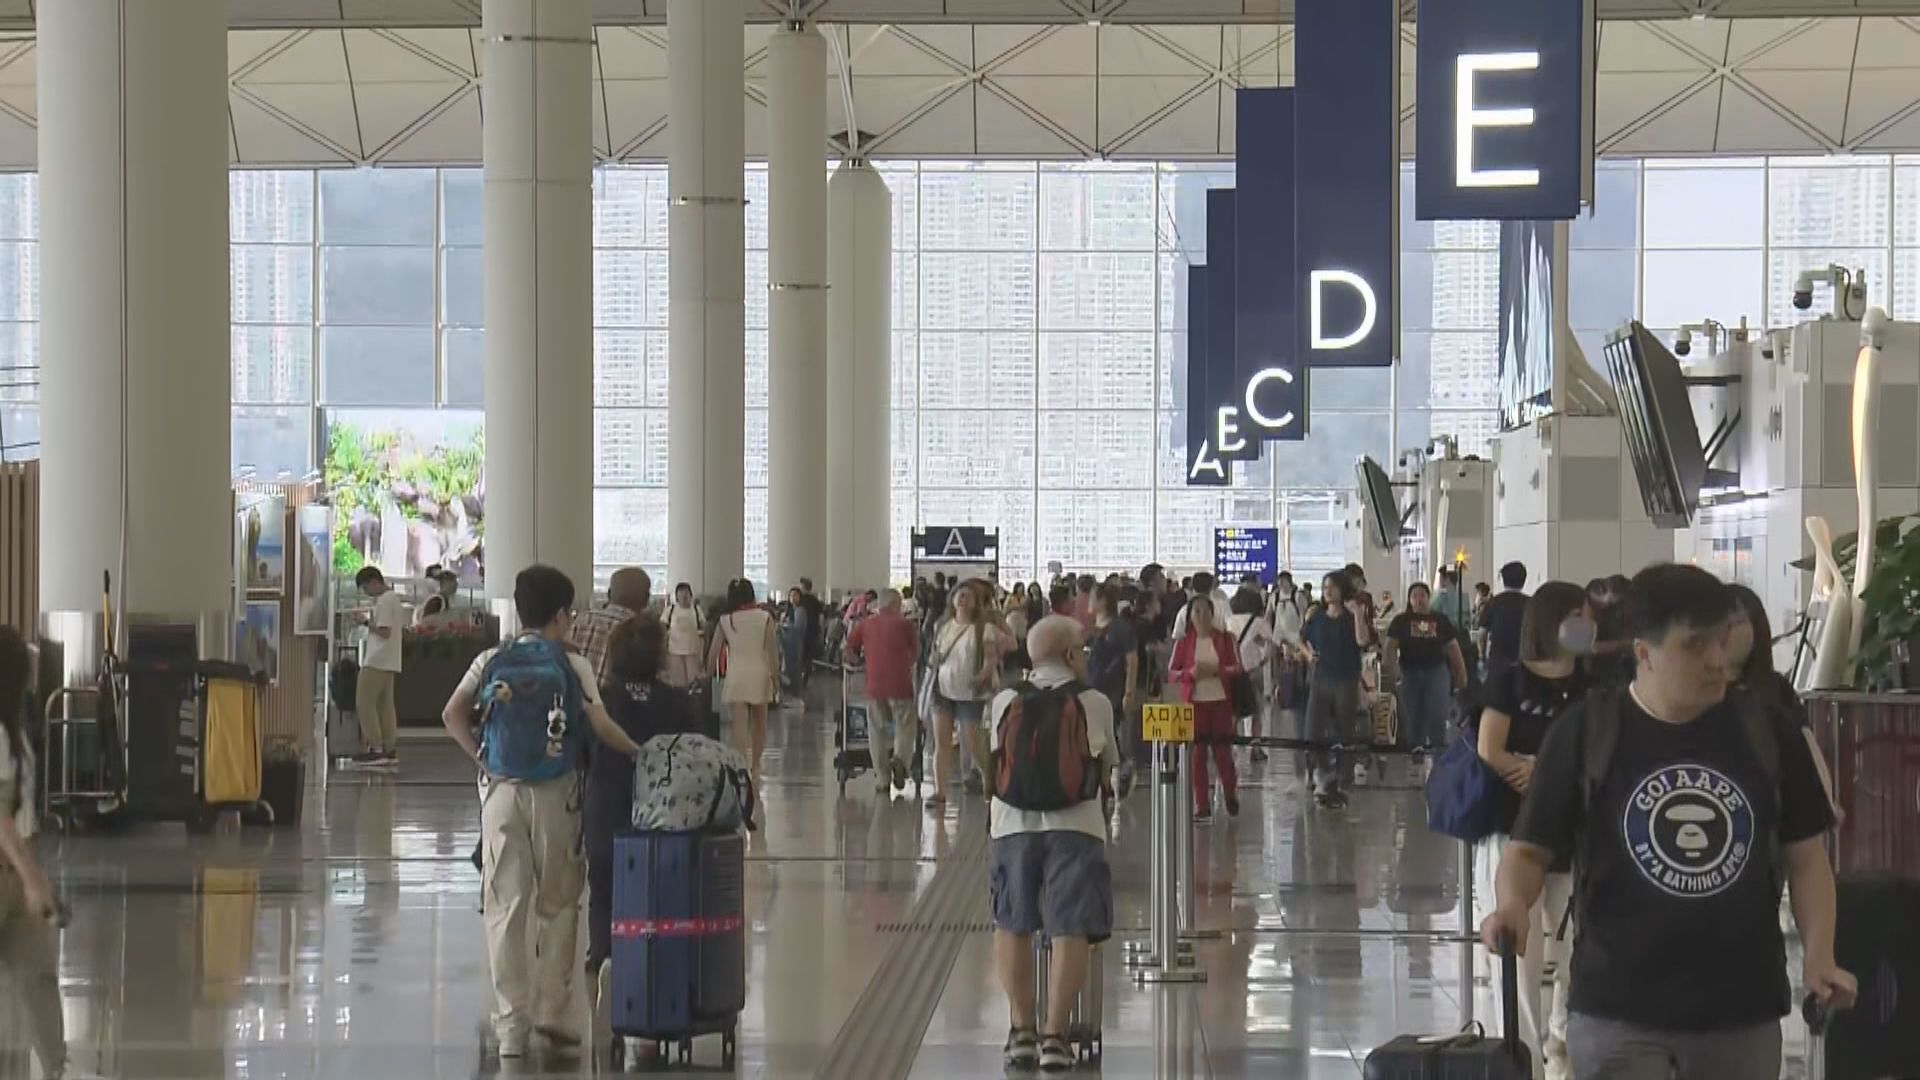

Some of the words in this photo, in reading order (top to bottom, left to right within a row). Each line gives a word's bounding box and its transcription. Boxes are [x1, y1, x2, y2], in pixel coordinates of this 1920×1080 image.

[1455, 51, 1540, 188] E
[1310, 269, 1377, 350] D
[1245, 367, 1294, 428] C
[1190, 437, 1225, 480] A
[942, 527, 968, 557] A
[1145, 706, 1169, 722] 入口
[1173, 706, 1193, 722] 入口
[1635, 773, 1672, 811] GO!
[1675, 769, 1744, 812] AAPE
[1663, 872, 1722, 892] BATHING
